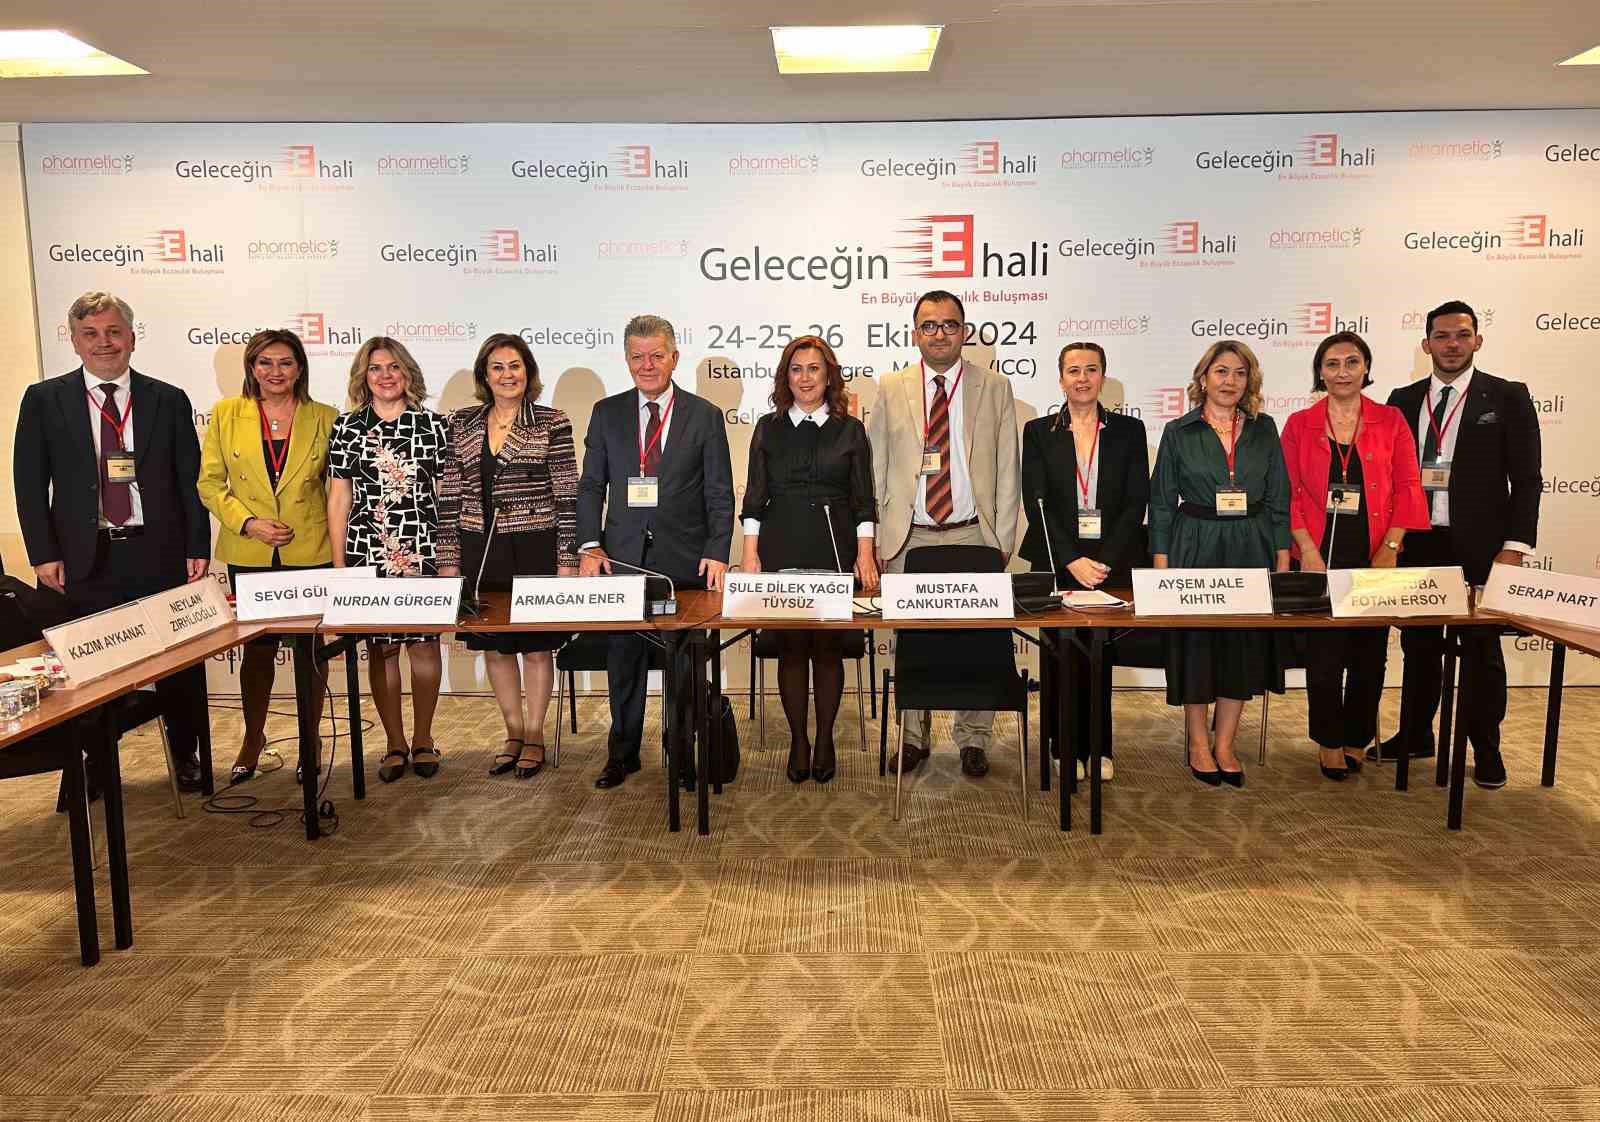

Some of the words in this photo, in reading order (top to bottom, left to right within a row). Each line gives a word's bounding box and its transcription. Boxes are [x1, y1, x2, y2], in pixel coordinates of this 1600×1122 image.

[175, 160, 273, 182] Geleceğin
[319, 160, 353, 178] hali
[511, 160, 608, 182] Geleceğin
[654, 160, 688, 178] hali
[860, 158, 957, 180] Geleceğin
[1002, 155, 1037, 173] hali
[1195, 150, 1294, 172] Geleceğin
[1340, 148, 1376, 166] hali
[1058, 238, 1155, 260] Geleceğin
[1201, 234, 1236, 253] hali
[1403, 231, 1502, 253] Geleceğin
[1549, 228, 1584, 247] hali
[49, 244, 145, 267] Geleceğin
[189, 244, 224, 262] hali
[380, 244, 477, 266] Geleceğin
[523, 244, 557, 262] hali
[700, 245, 888, 290] Geleceğin
[983, 241, 1048, 277] hali
[861, 293, 878, 304] En
[983, 290, 1048, 304] Buluşması
[327, 327, 362, 345] hali
[519, 327, 614, 349] Geleceğin
[962, 320, 1037, 346] 2024
[1190, 319, 1289, 340] Geleceğin
[707, 359, 775, 379] İstanbu
[1541, 475, 1600, 497] eleceğ
[254, 586, 299, 602] SEVGİ
[729, 582, 766, 596] ŞULE
[768, 580, 806, 594] DİLEK
[808, 580, 850, 595] YAĞCI
[915, 583, 979, 594] MUSTAFA
[1158, 578, 1206, 592] AYŞEM
[1208, 577, 1245, 589] JALE
[169, 592, 203, 614] NEYLAN
[333, 596, 390, 606] NURDAN
[393, 593, 452, 607] GÜRGEN
[515, 592, 586, 606] ARMAĞAN
[588, 593, 625, 605] ENER
[761, 594, 815, 609] TÜYSÜZ
[896, 596, 999, 610] CANKURTARAN
[1179, 593, 1226, 605] KIHTIR
[1401, 594, 1448, 606] ERSOY
[1507, 584, 1554, 600] SERAP
[1556, 591, 1598, 608] NART
[169, 605, 218, 633] ZIRHLIOĞLU
[68, 638, 103, 660] KAZIM
[103, 623, 147, 650] AYKANAT
